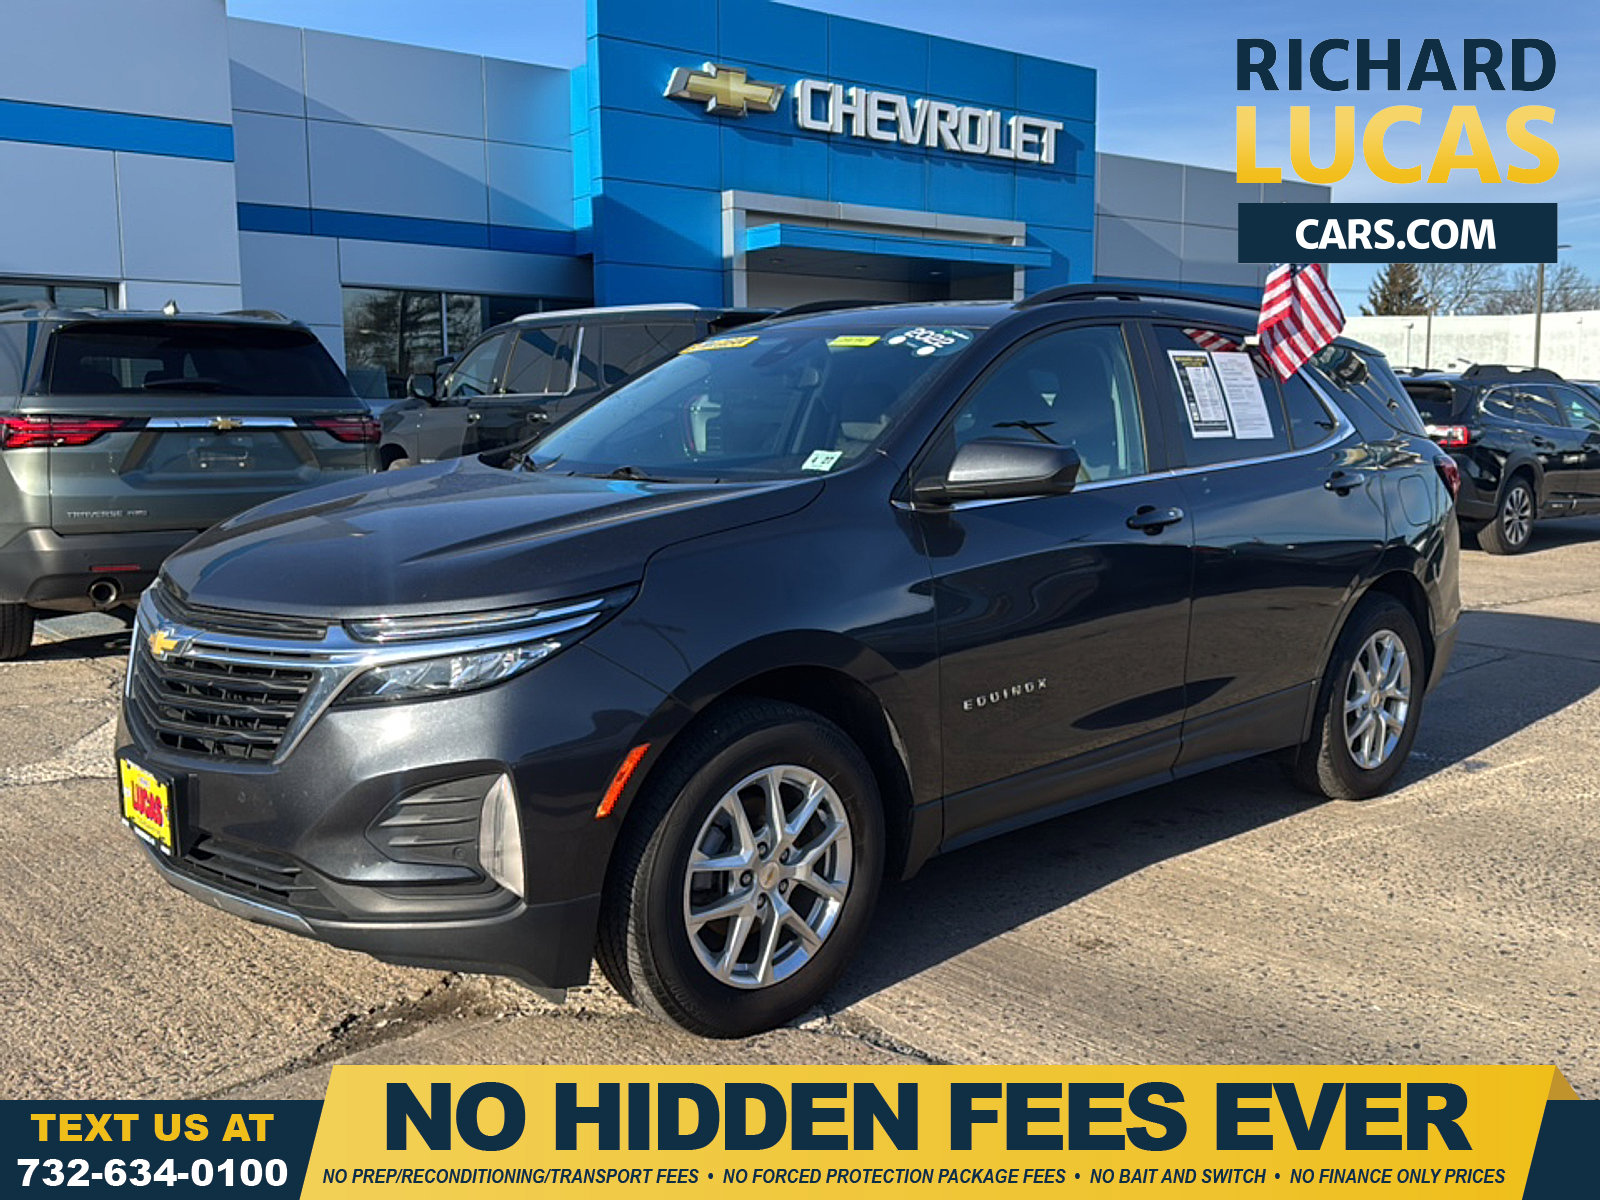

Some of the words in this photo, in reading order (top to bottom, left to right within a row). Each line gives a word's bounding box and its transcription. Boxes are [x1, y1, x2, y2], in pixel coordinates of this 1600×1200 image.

[795, 79, 1064, 164] CHEVROLET
[963, 678, 1047, 711] EQUINOX
[132, 781, 164, 828] LUCAS
